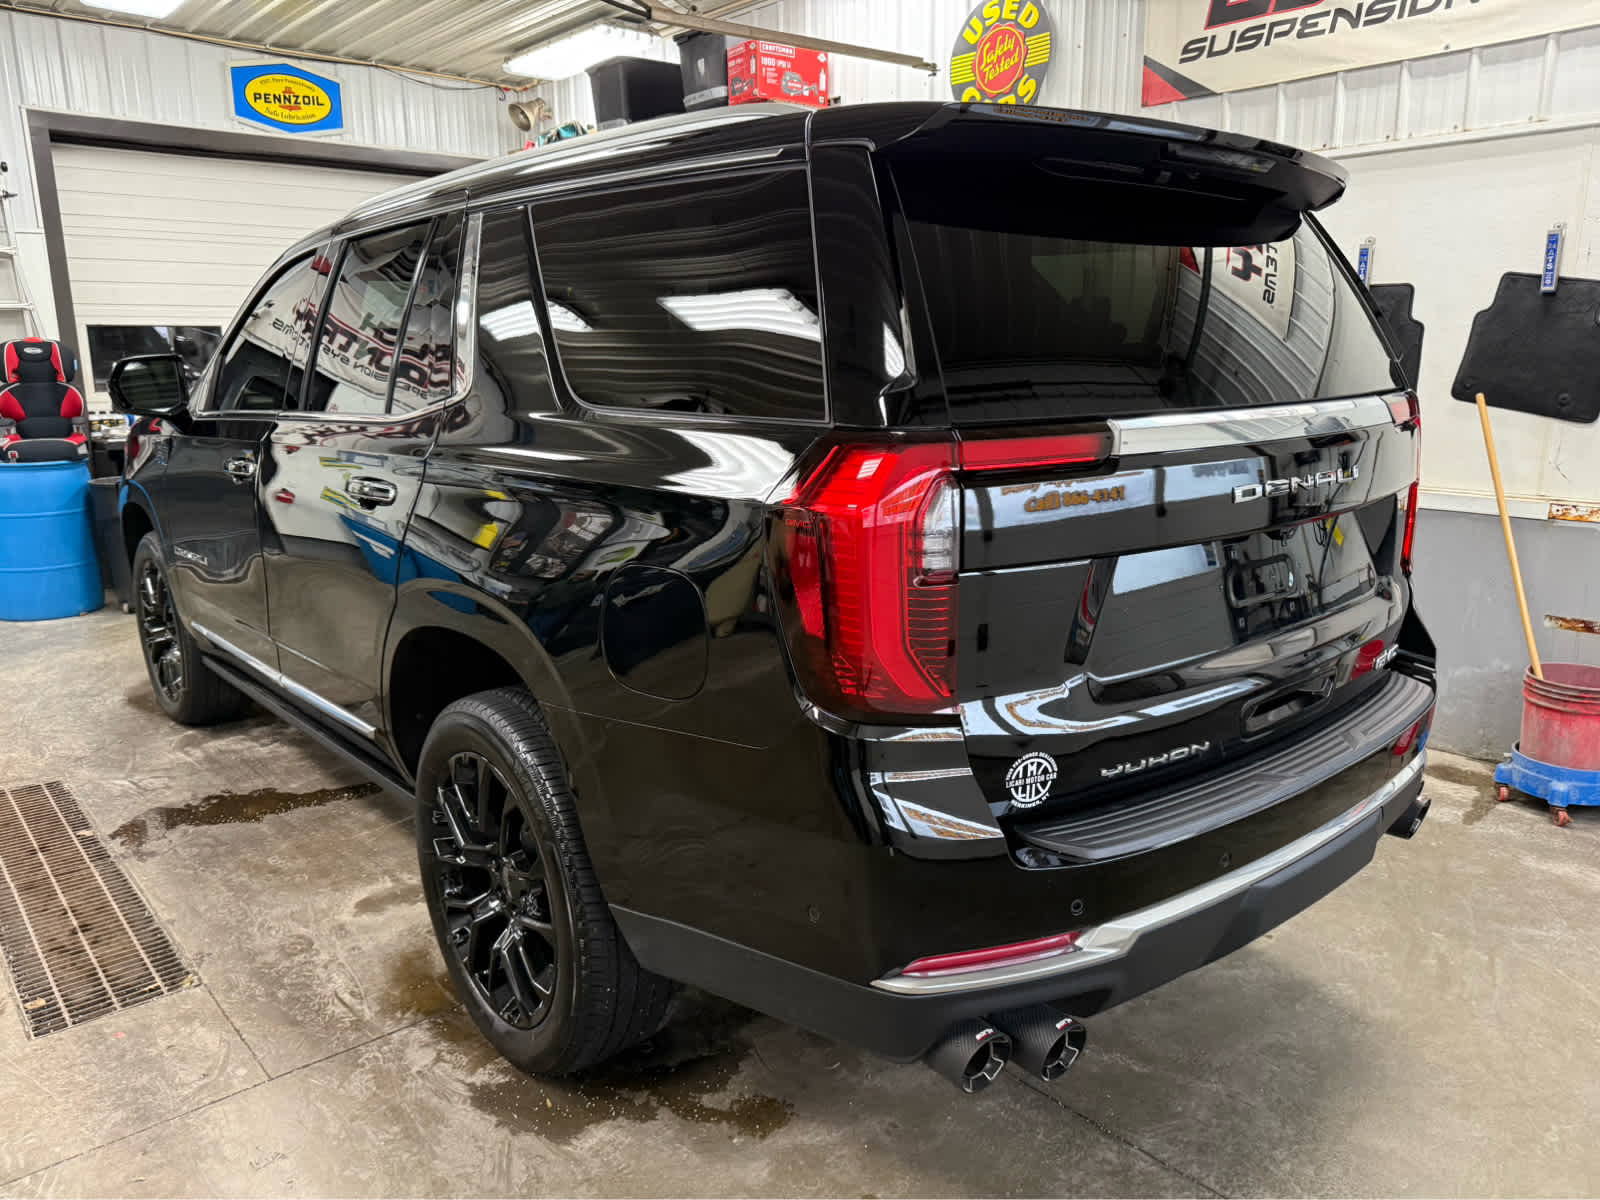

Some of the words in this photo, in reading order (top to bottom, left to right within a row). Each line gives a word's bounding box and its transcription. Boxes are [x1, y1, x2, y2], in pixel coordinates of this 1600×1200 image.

[962, 0, 1040, 45] USED
[981, 34, 1016, 70] Safety
[984, 46, 1019, 84] Tested
[253, 92, 325, 106] PENNZOIL
[961, 73, 1037, 104] CS
[1232, 464, 1359, 503] DENALI
[1099, 741, 1210, 777] YUKON
[1005, 779, 1024, 788] LICARI
[1026, 775, 1045, 784] MOTOR
[1046, 772, 1057, 781] CAR
